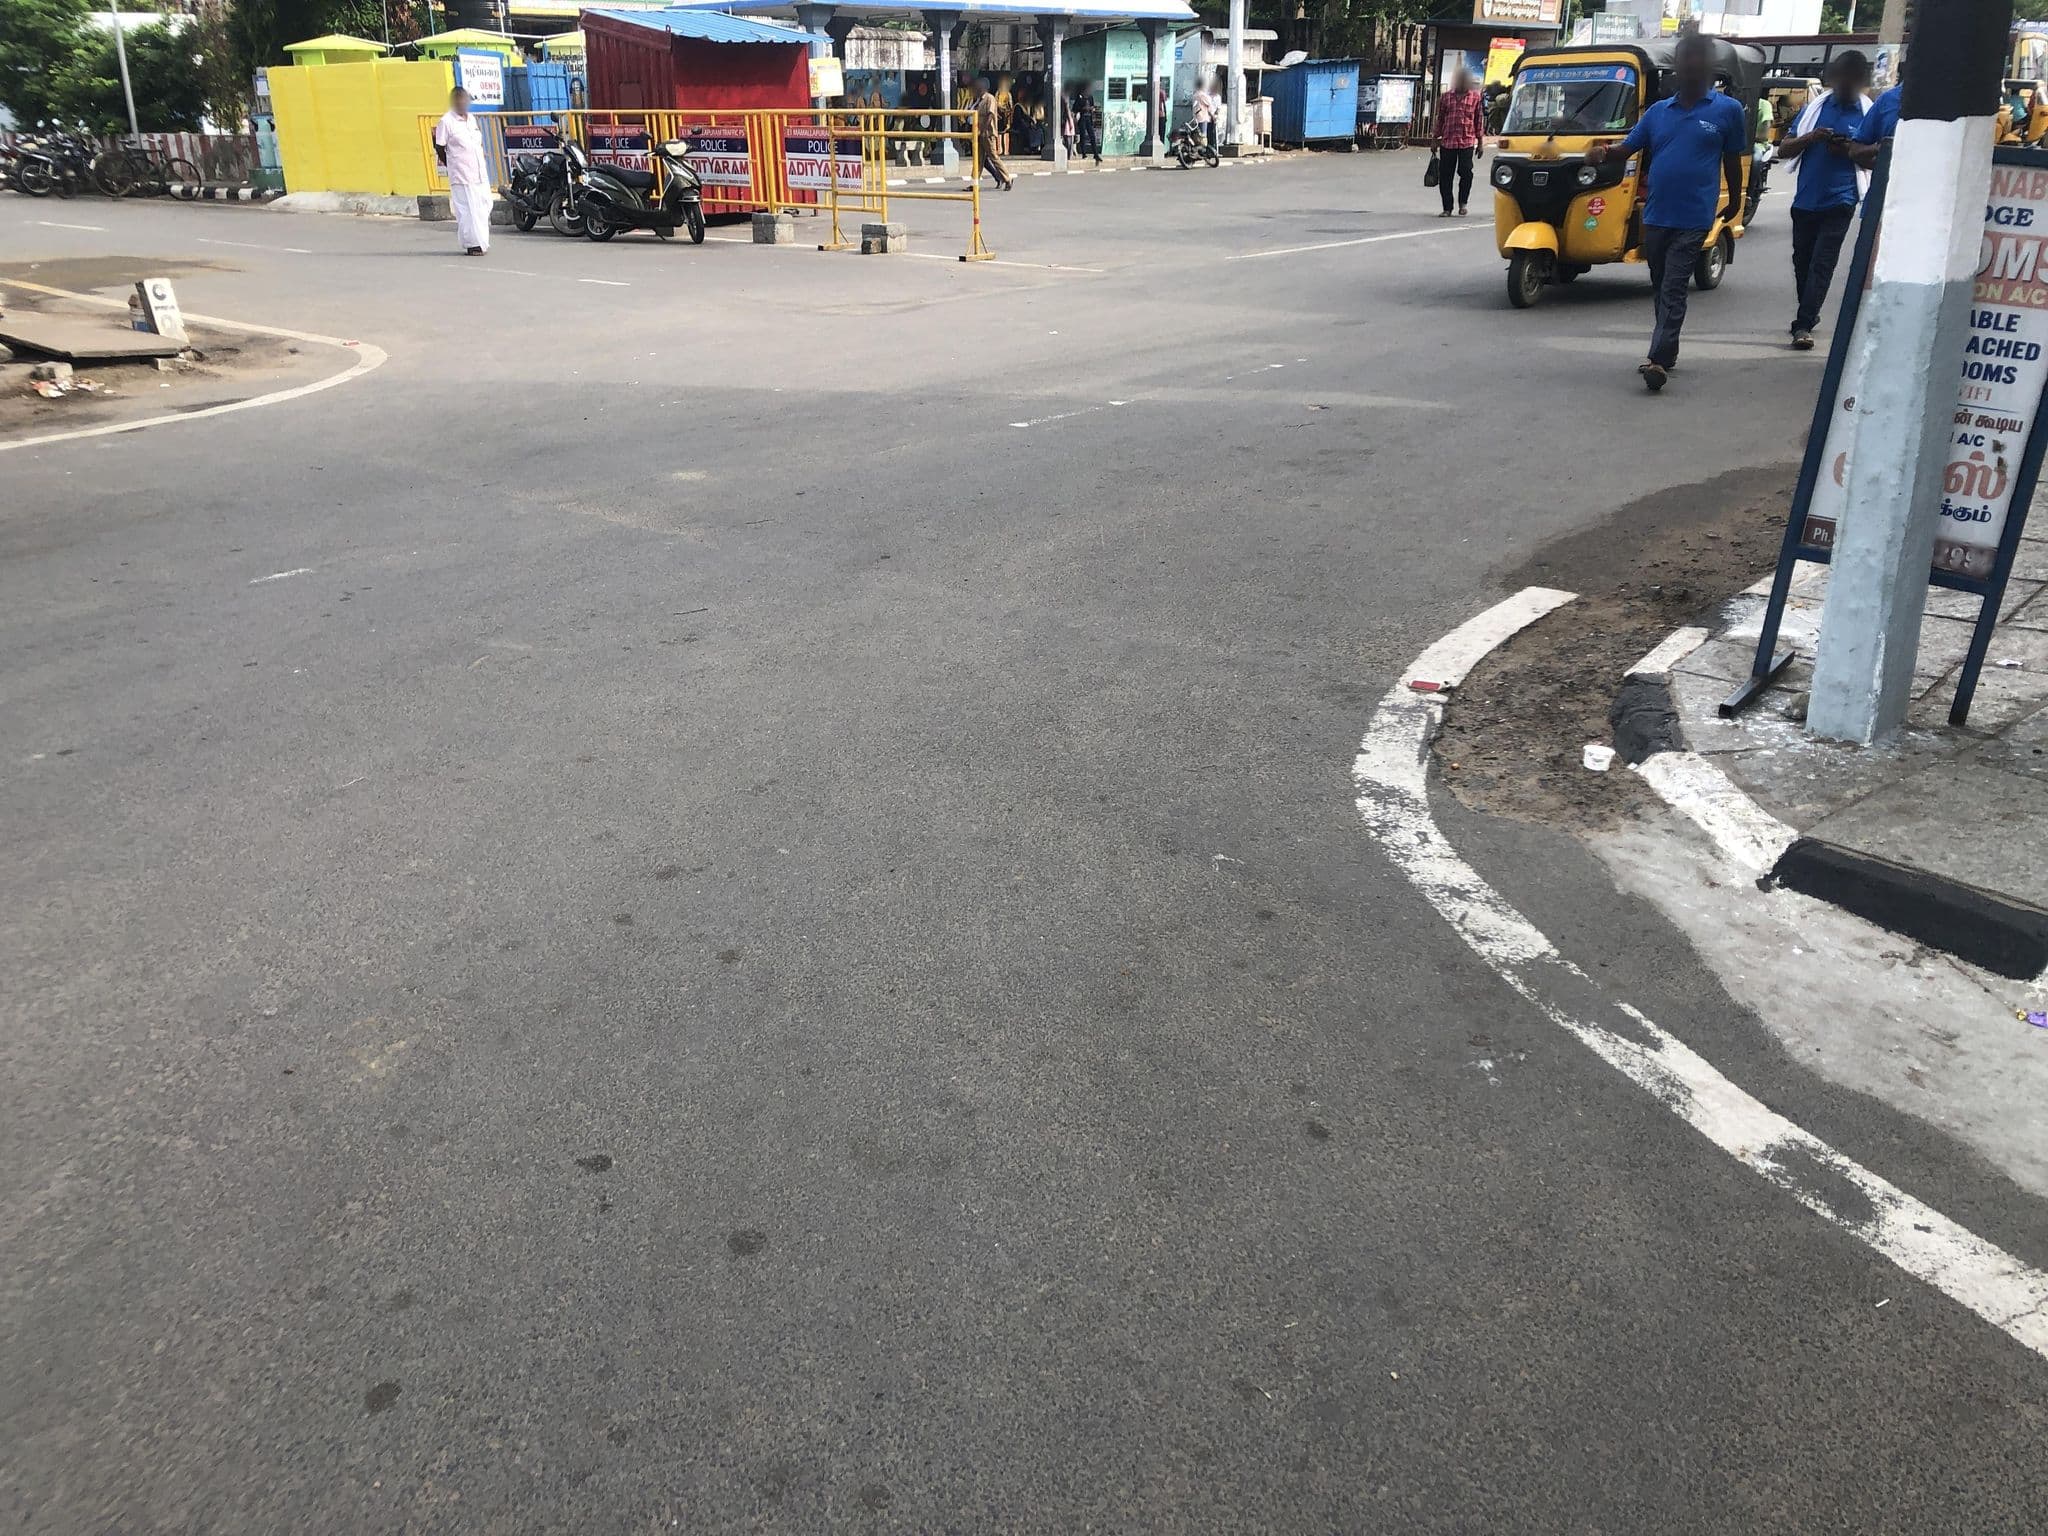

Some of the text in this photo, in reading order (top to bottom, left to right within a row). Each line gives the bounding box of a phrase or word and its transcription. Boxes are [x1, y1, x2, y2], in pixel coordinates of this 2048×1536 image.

[522, 138, 543, 148] POLICE
[700, 139, 728, 151] POLICE
[690, 158, 749, 175] DITYARAM
[788, 159, 862, 179] ADITYARAM
[2009, 286, 2047, 305] A/C
[1966, 336, 2041, 361] ACHED
[1961, 360, 2018, 384] OMS
[1957, 432, 1985, 447] A/C
